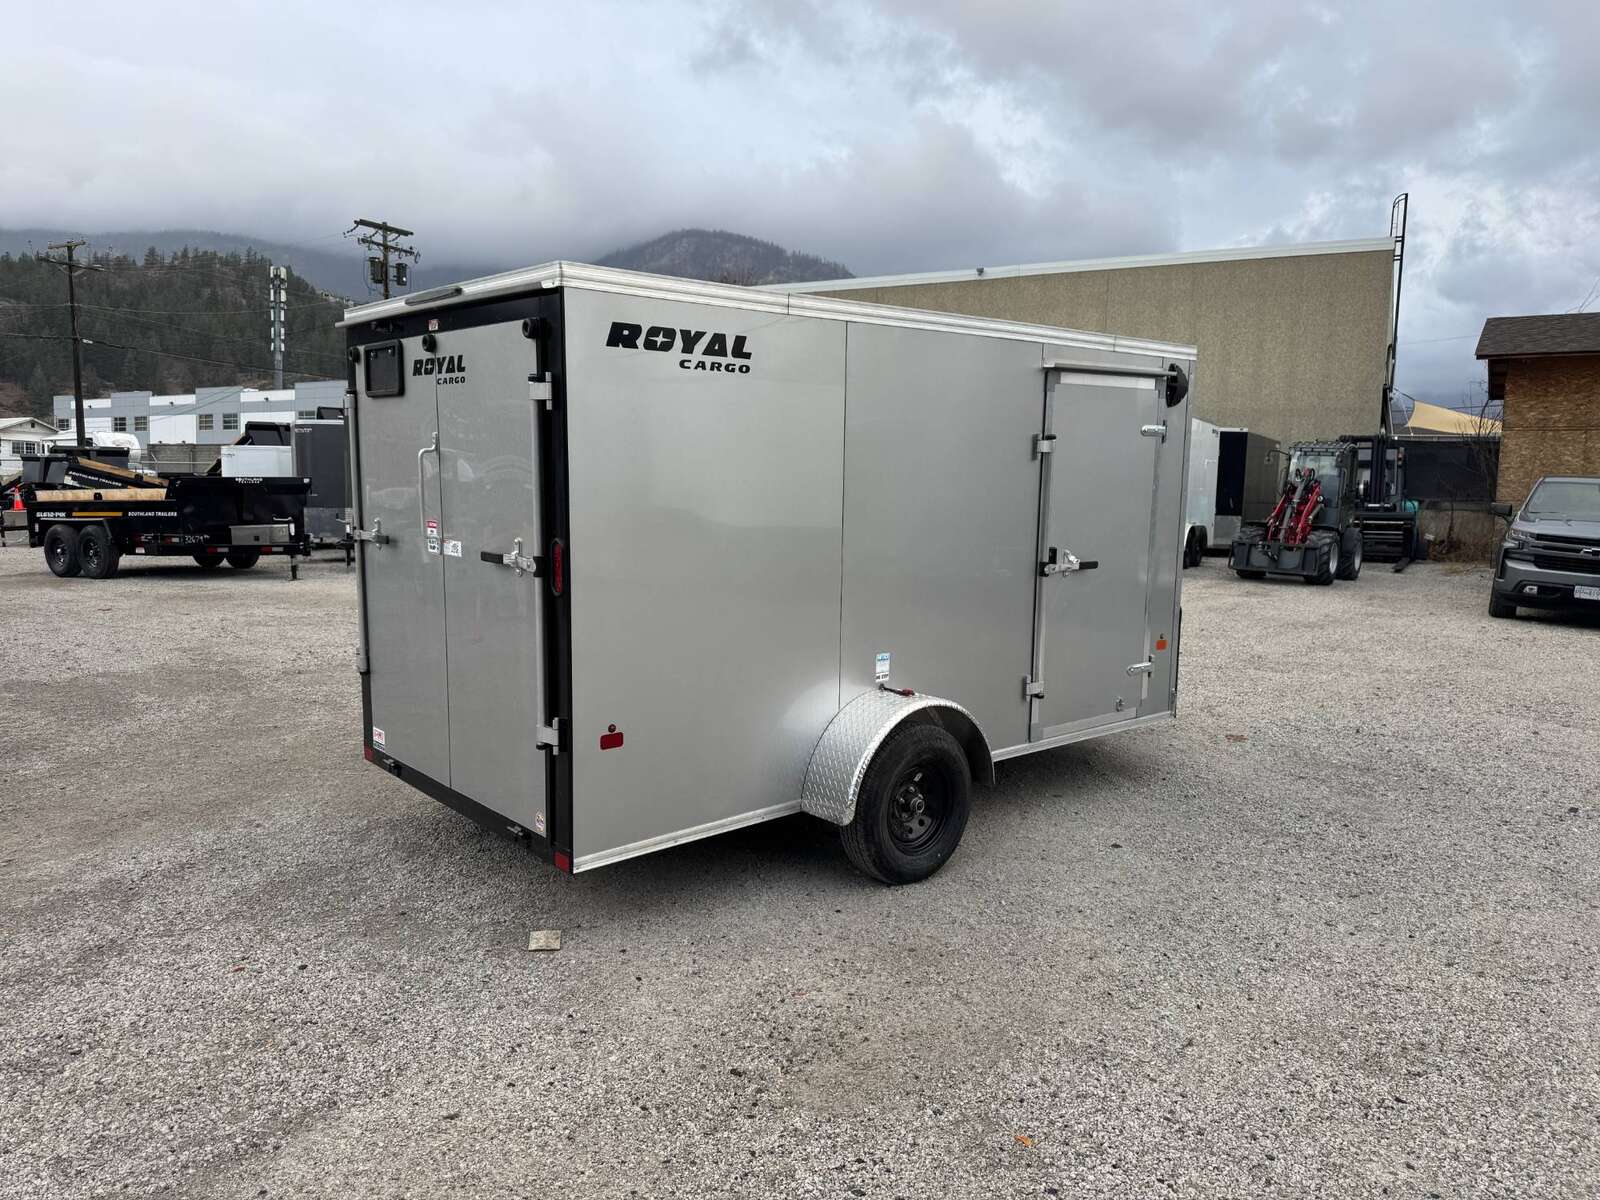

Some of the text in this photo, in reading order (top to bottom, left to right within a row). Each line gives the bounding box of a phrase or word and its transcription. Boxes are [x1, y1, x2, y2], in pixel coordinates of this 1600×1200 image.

[606, 321, 752, 360] ROYAL
[412, 354, 466, 377] ROYAL
[679, 359, 751, 374] CARGO
[437, 376, 466, 385] CARGO
[68, 470, 99, 481] SOUTHLAND
